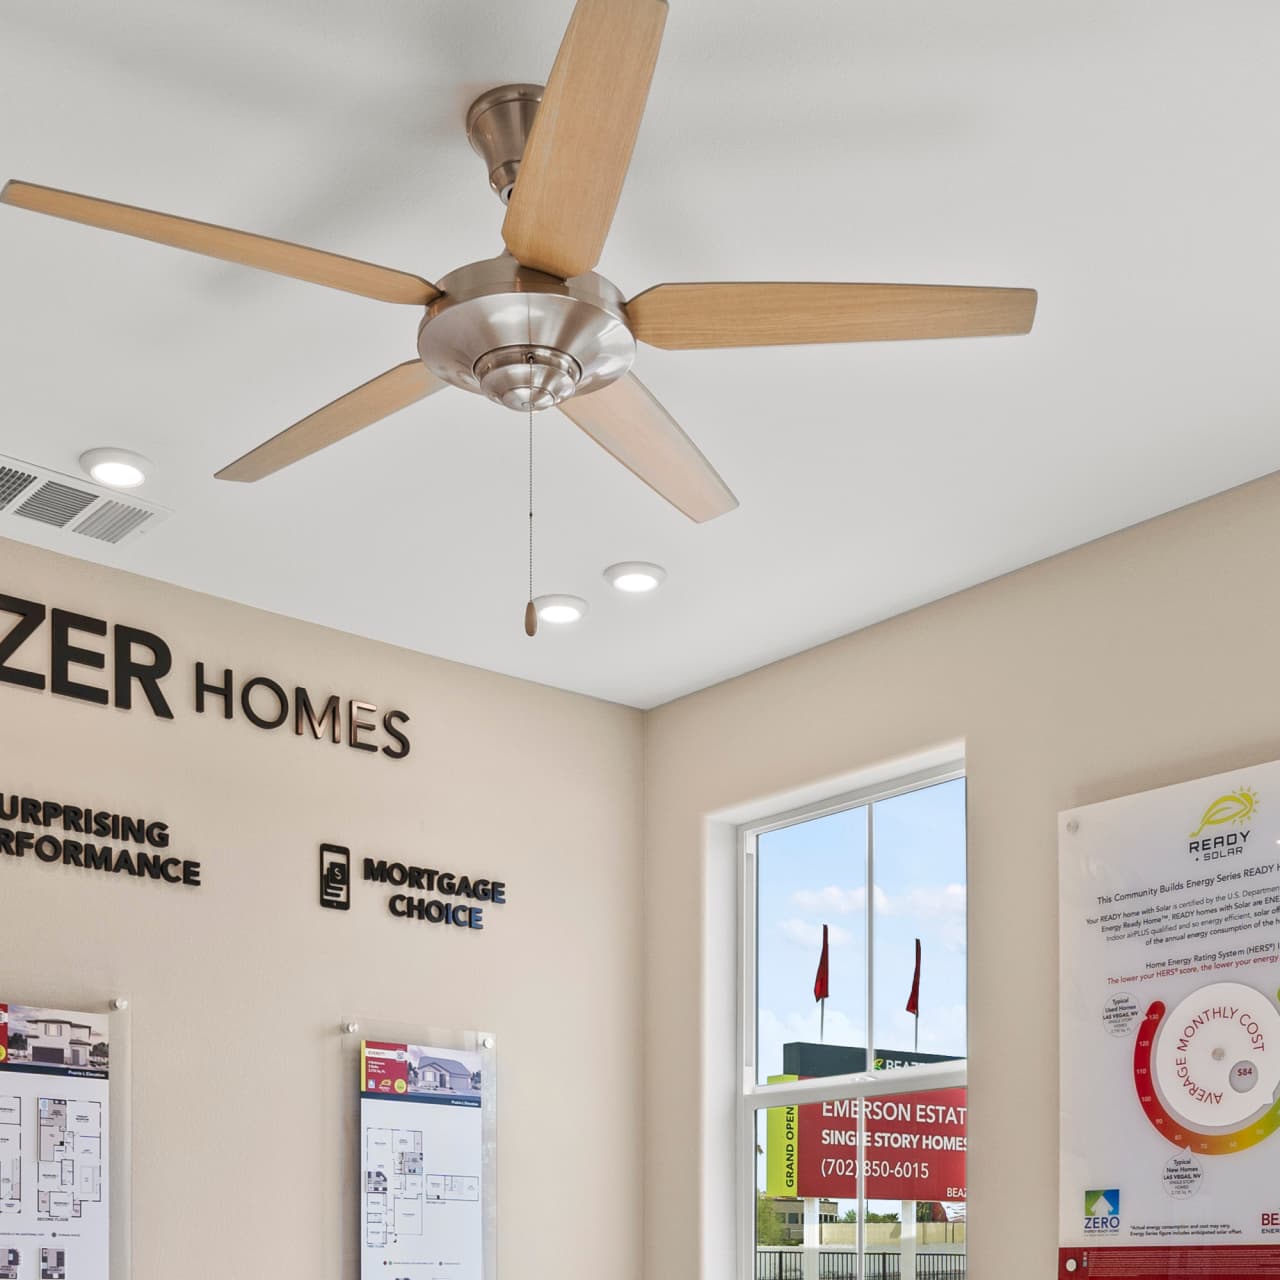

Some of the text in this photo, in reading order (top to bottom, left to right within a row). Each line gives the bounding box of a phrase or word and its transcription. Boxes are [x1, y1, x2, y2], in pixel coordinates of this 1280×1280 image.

[195, 662, 411, 759] HOMES
[1189, 831, 1250, 853] READY
[1203, 847, 1243, 861] SOLAR
[363, 857, 506, 904] MORTGAGE
[1097, 896, 1112, 904] This
[1114, 888, 1158, 902] Community
[1160, 882, 1184, 893] Builds
[1186, 878, 1215, 888] Energy
[1216, 872, 1241, 882] Series
[1244, 864, 1274, 878] READY
[388, 894, 484, 929] CHOICE
[1100, 913, 1122, 922] READY
[1142, 907, 1154, 915] with
[1156, 904, 1171, 912] Solar
[1172, 910, 1194, 920] READY
[1196, 907, 1218, 915] homes
[1219, 904, 1233, 912] with
[1234, 901, 1251, 909] Solar
[1179, 921, 1190, 929] and
[1201, 917, 1224, 925] energy
[1254, 909, 1269, 917] solar
[1145, 938, 1153, 946] of
[1165, 933, 1186, 943] annual
[1187, 930, 1208, 938] energy
[1209, 922, 1252, 935] consumption
[1253, 920, 1261, 928] of
[1262, 918, 1274, 927] the
[1167, 957, 1192, 966] Energy
[1193, 952, 1217, 962] Rating
[1218, 949, 1245, 959] System
[1120, 975, 1138, 983] lower
[1139, 973, 1155, 982] your
[1201, 963, 1212, 971] the
[1214, 961, 1233, 969] lower
[1234, 959, 1251, 968] your
[1253, 955, 1279, 963] energy
[1177, 1007, 1265, 1052] MONTHLY COST
[1176, 1057, 1224, 1105] AVERAGE
[1237, 1068, 1252, 1077] $84
[822, 1100, 911, 1121] EMERSON
[821, 1129, 872, 1147] SINGE
[874, 1132, 920, 1149] STORY
[786, 1143, 795, 1188] GRAND
[1084, 1216, 1120, 1229] ZERO
